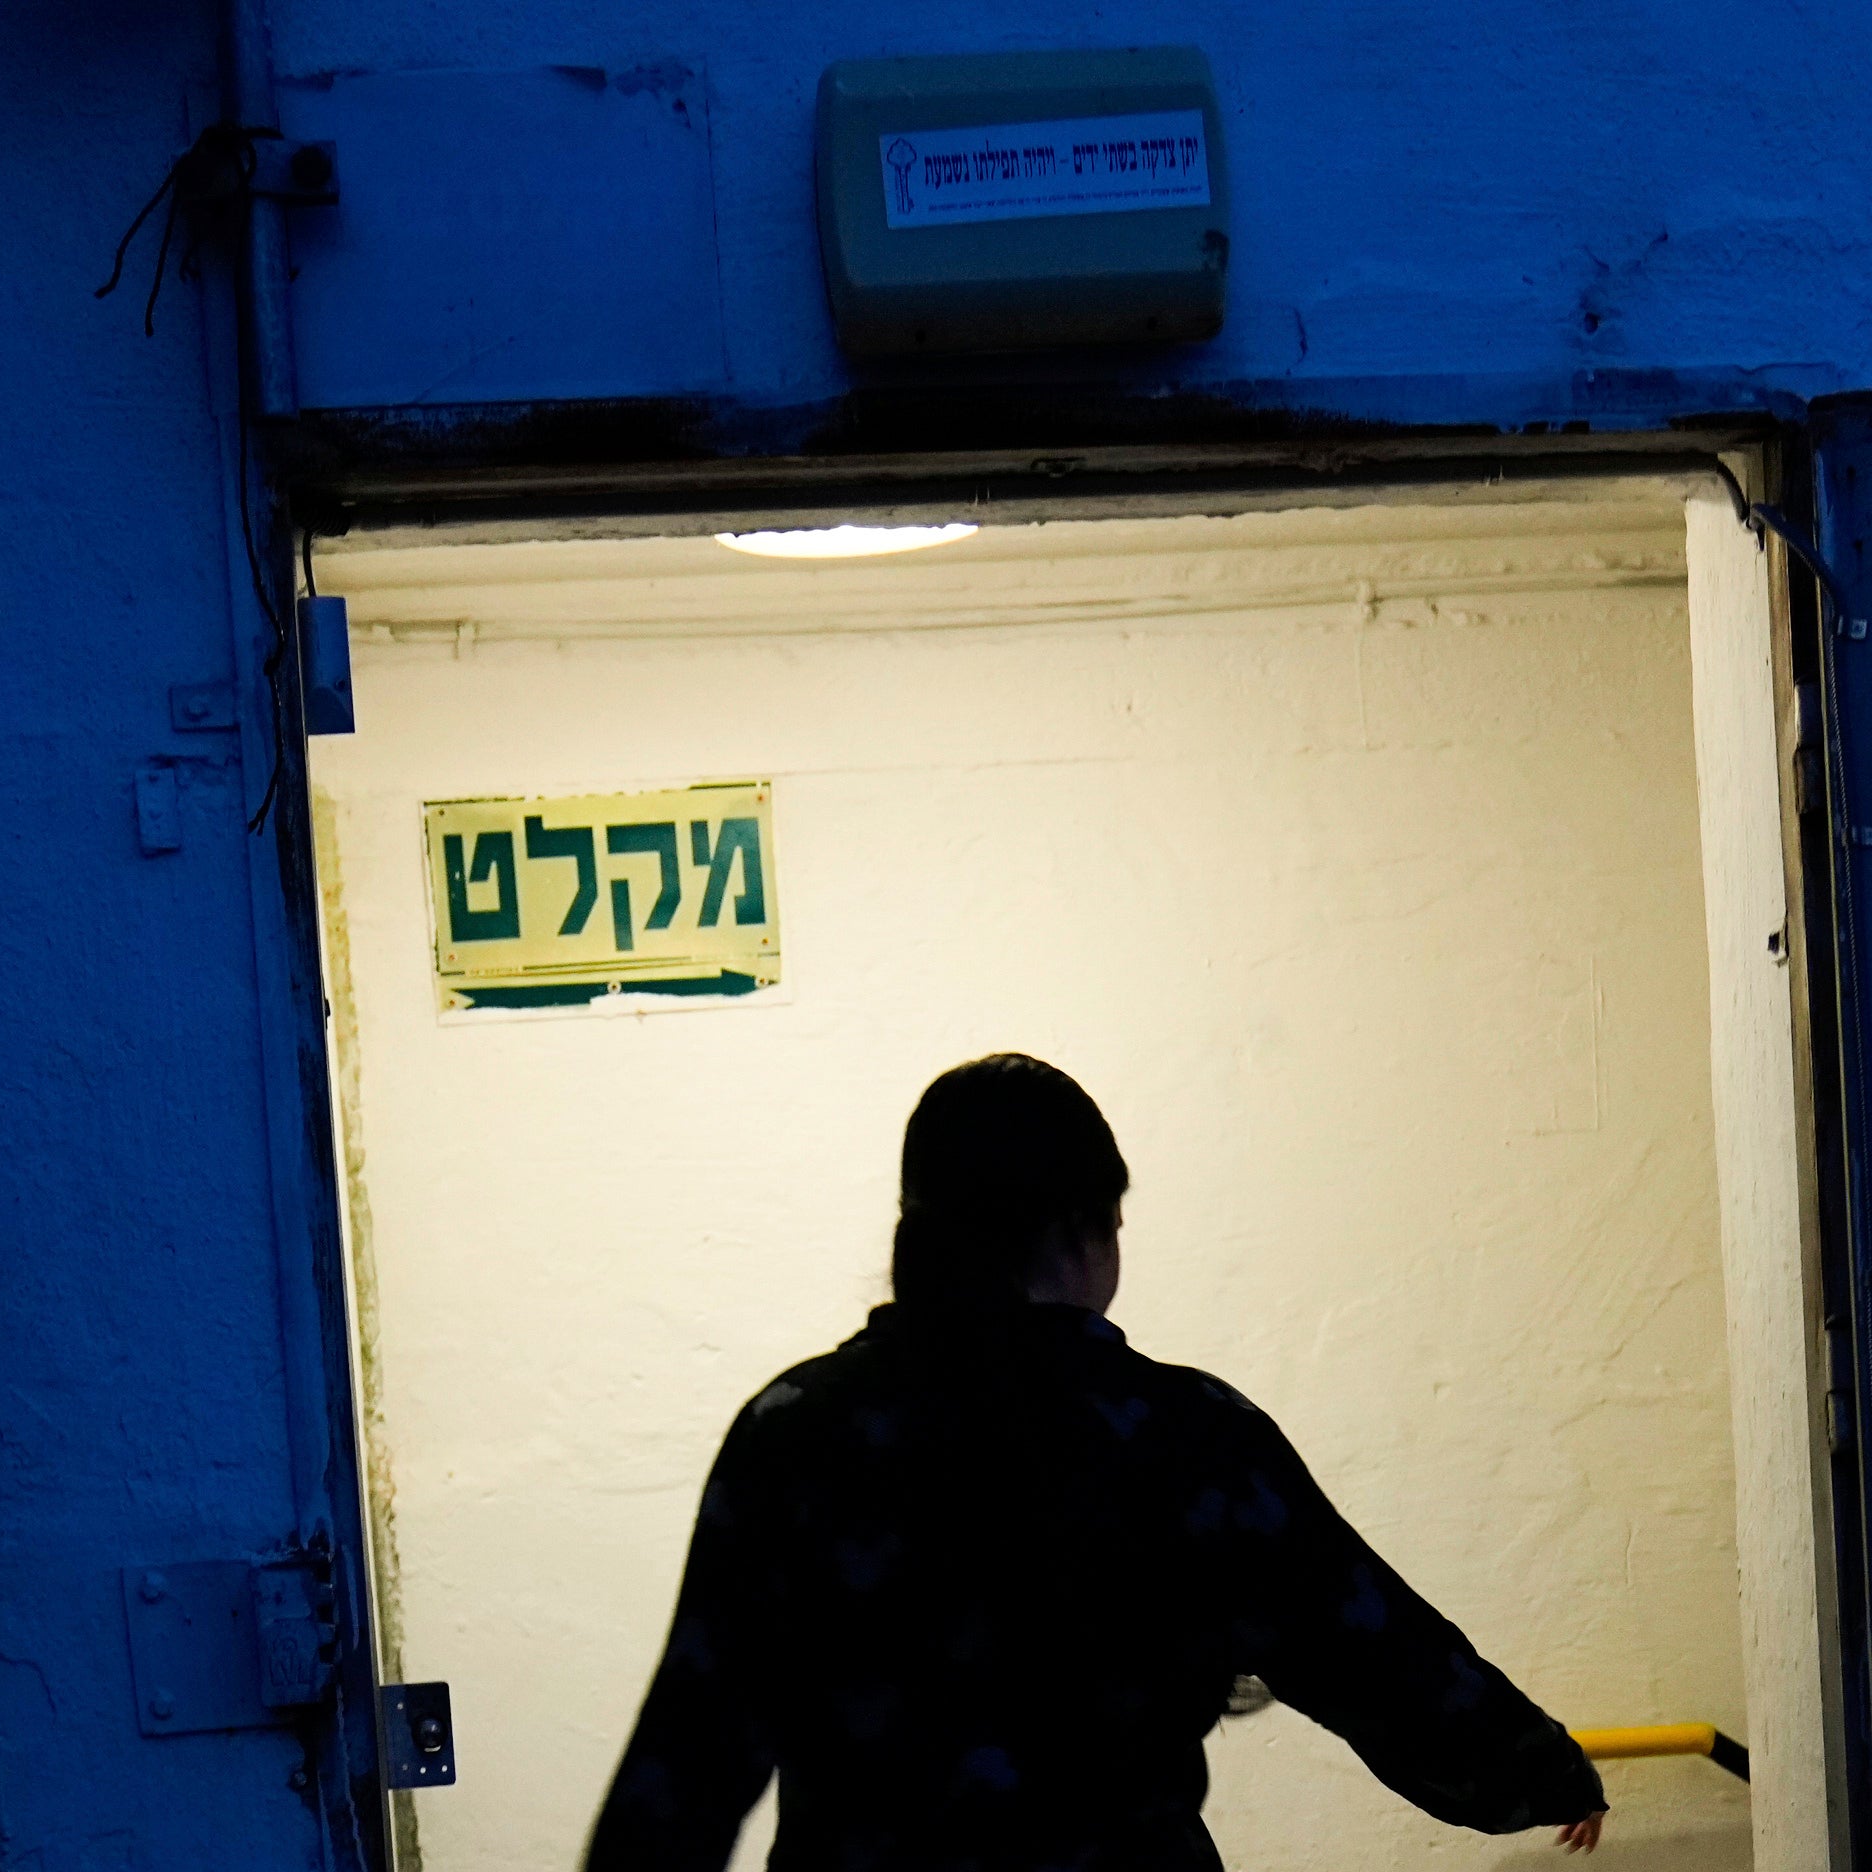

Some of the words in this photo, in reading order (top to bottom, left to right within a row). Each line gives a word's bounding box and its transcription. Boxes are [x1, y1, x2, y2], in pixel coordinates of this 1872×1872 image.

[924, 152, 970, 190] נשמעת
[972, 138, 1020, 181] תפילתו
[1022, 145, 1056, 178] ויהיה
[1072, 143, 1099, 174] ידים
[1102, 141, 1138, 174] בשתי
[1140, 137, 1176, 179] צדקה
[1179, 136, 1199, 177] יתן
[442, 815, 767, 952] מקלט
